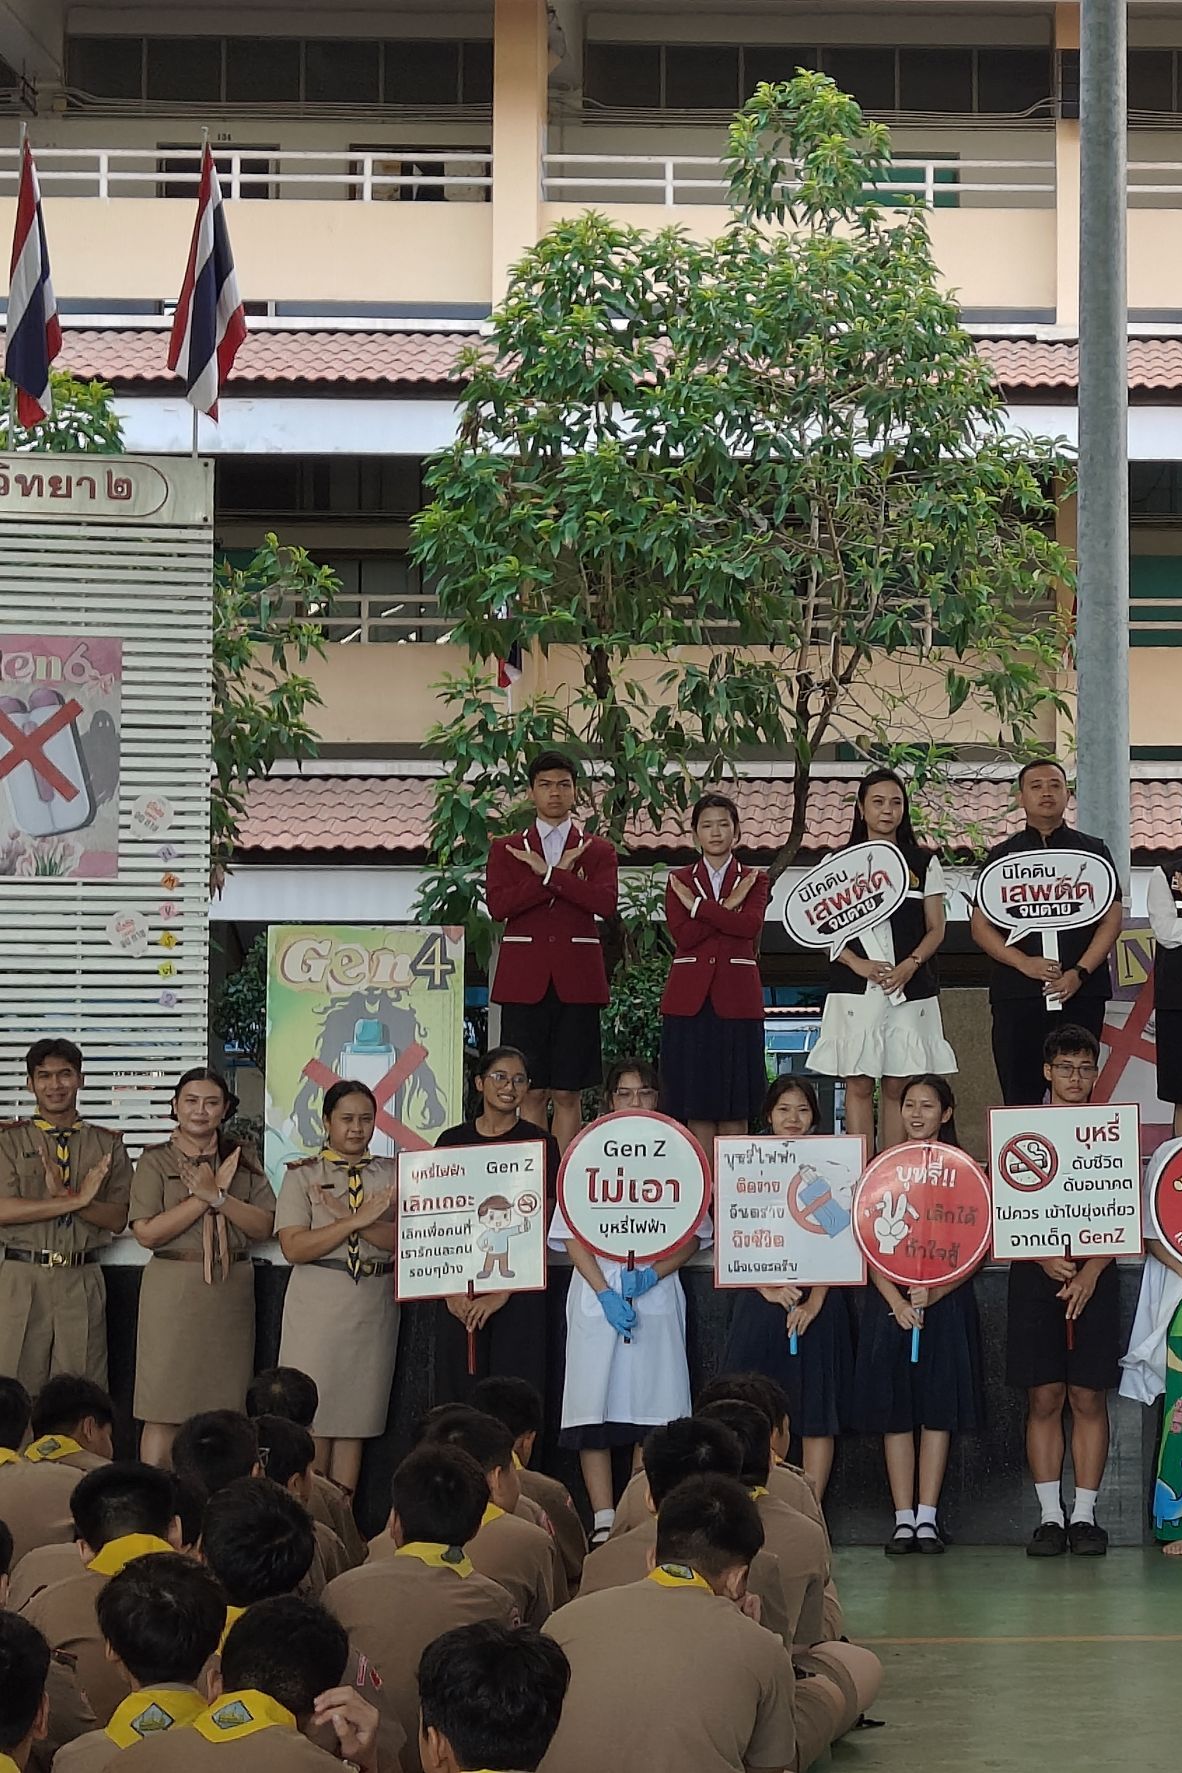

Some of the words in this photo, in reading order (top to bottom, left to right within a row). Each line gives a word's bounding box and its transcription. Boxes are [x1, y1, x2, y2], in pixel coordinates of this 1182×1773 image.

[1075, 1112, 1120, 1150] บุหรี่
[603, 1140, 647, 1157] Gen
[653, 1140, 666, 1157] Z
[487, 1161, 519, 1174] Gen
[524, 1158, 534, 1172] Z
[1072, 1154, 1123, 1170] ดับชีวิต
[586, 1167, 680, 1203] ไม่เอา
[1063, 1177, 1133, 1192] ดับอนาคต
[600, 1215, 667, 1238] บุหรี่ไฟฟ้า
[1010, 1227, 1071, 1247] จากเด็ก
